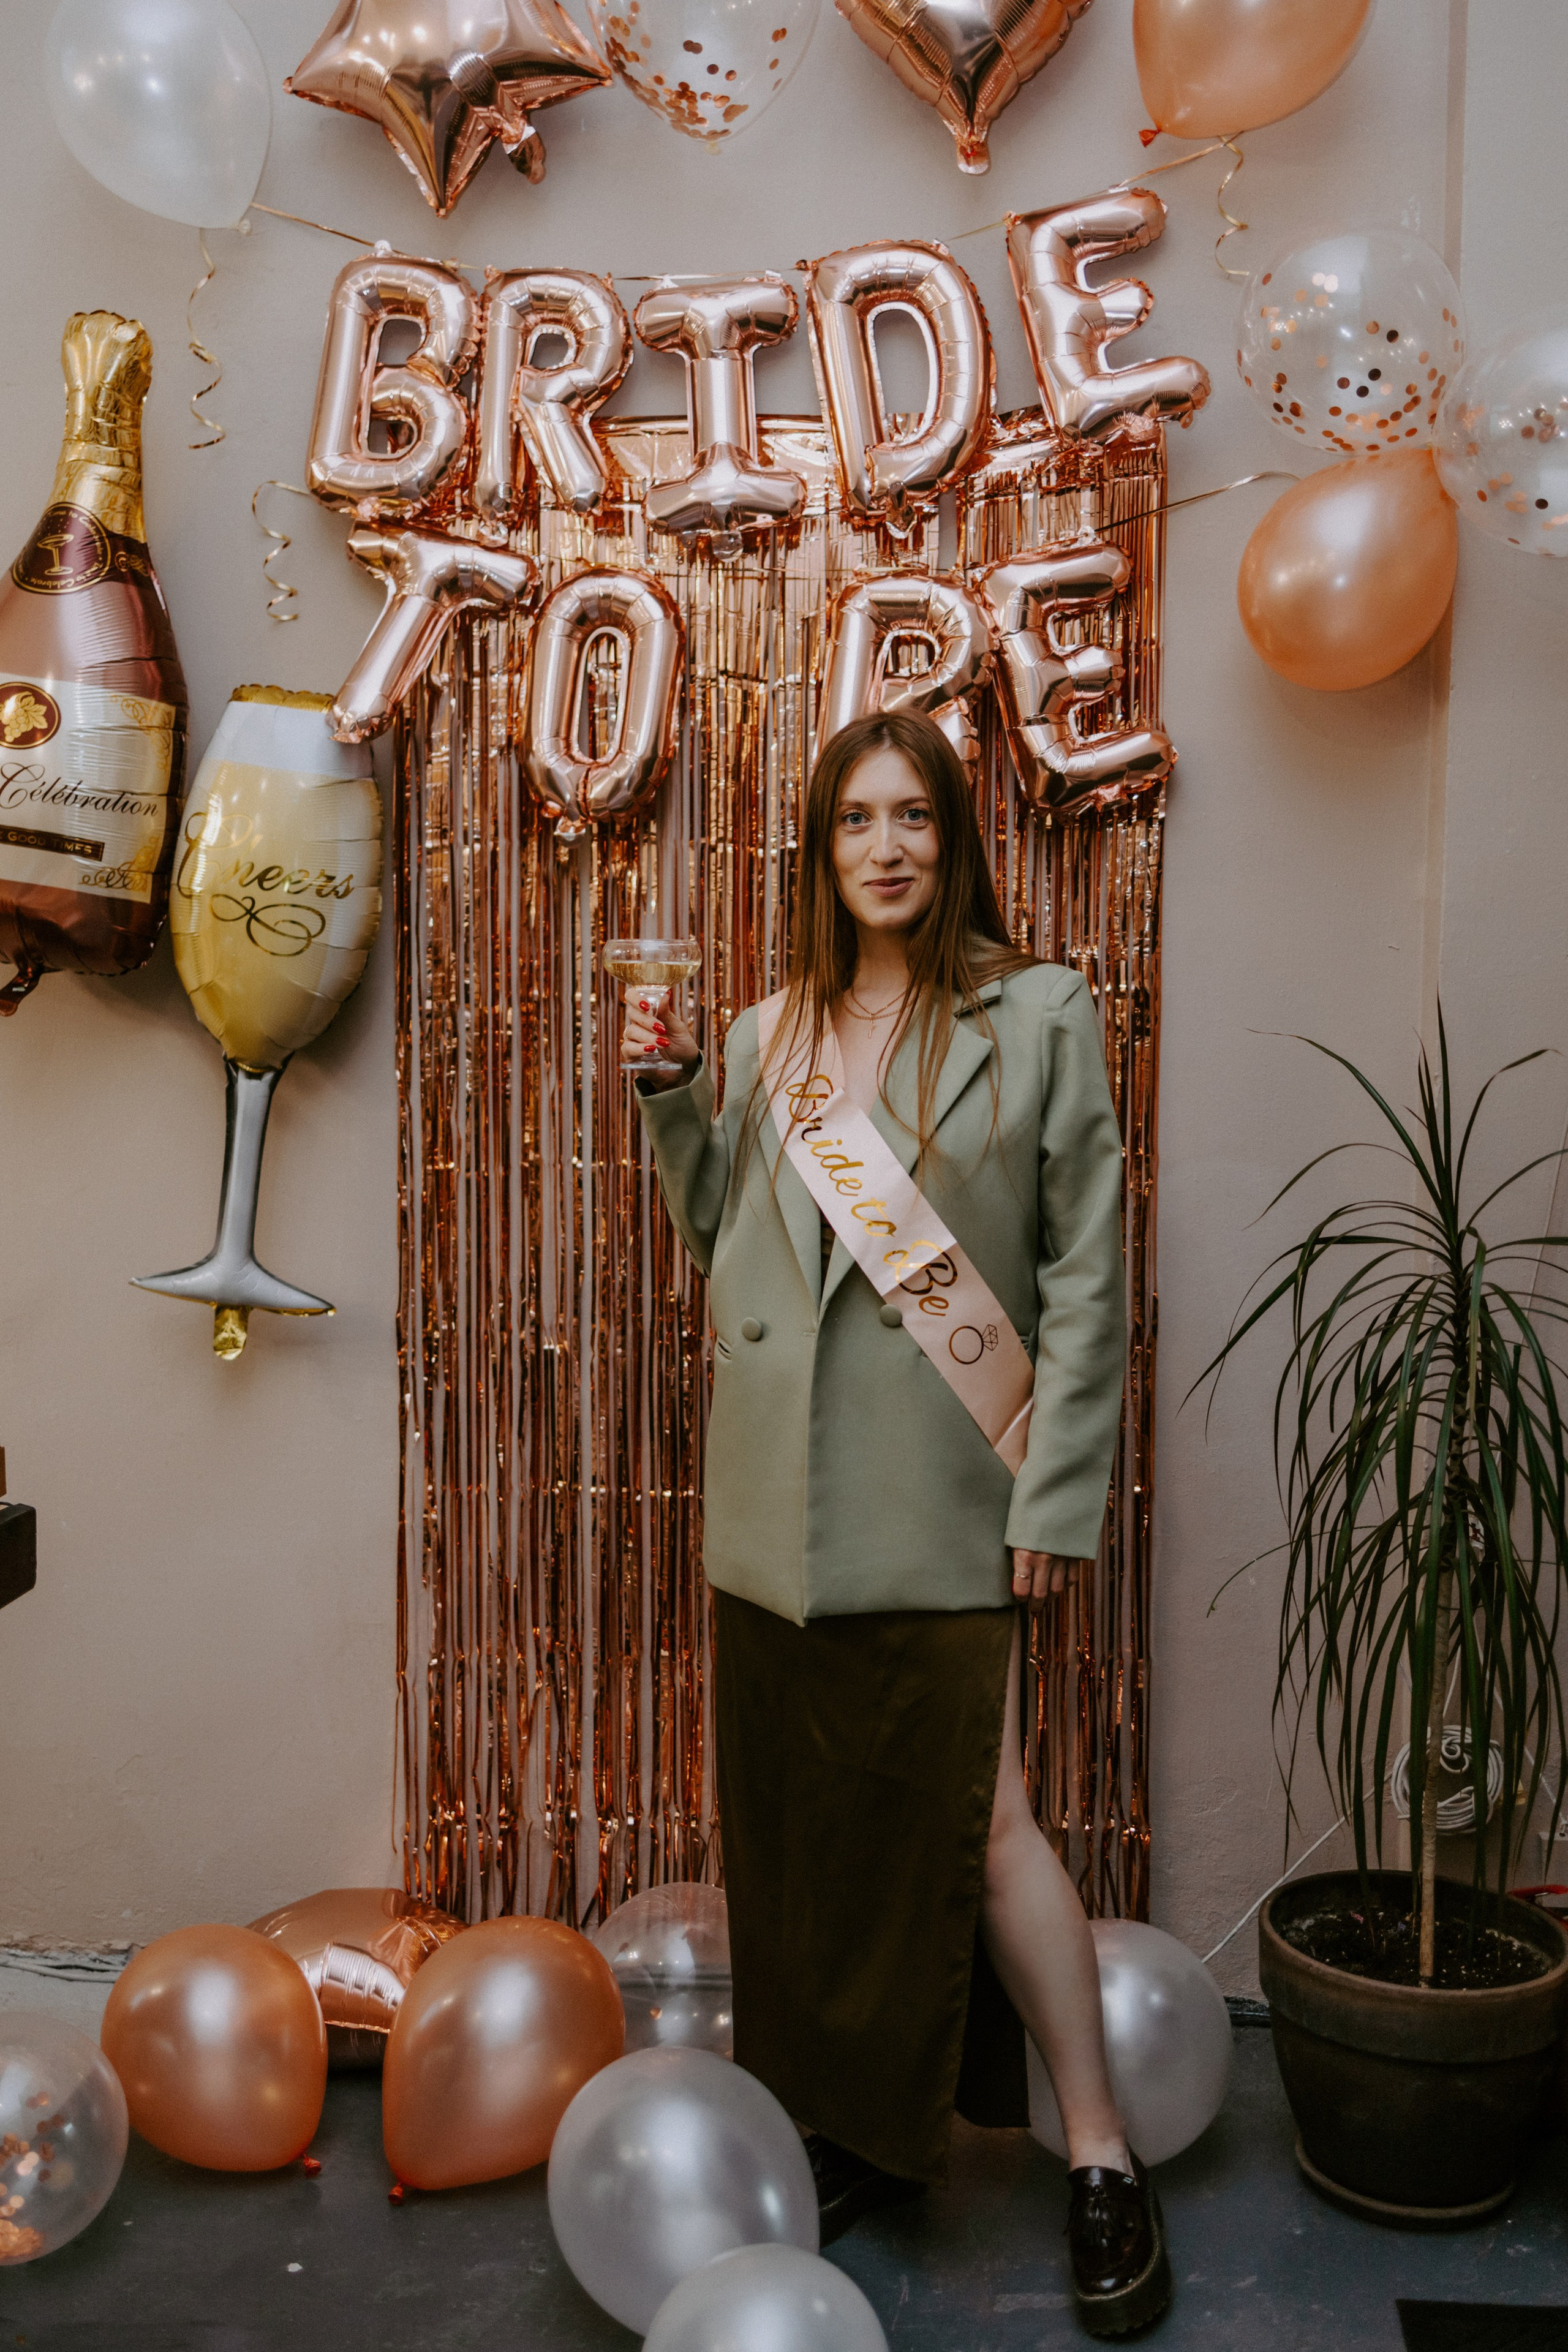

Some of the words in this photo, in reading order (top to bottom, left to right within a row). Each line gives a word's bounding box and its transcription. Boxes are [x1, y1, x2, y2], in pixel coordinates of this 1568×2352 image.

[306, 187, 1210, 535] BRIDE
[325, 519, 687, 827] TO
[7, 831, 47, 846] GOOD
[785, 1074, 864, 1196] Bride
[851, 1197, 897, 1238] to
[883, 1239, 958, 1317] Be
